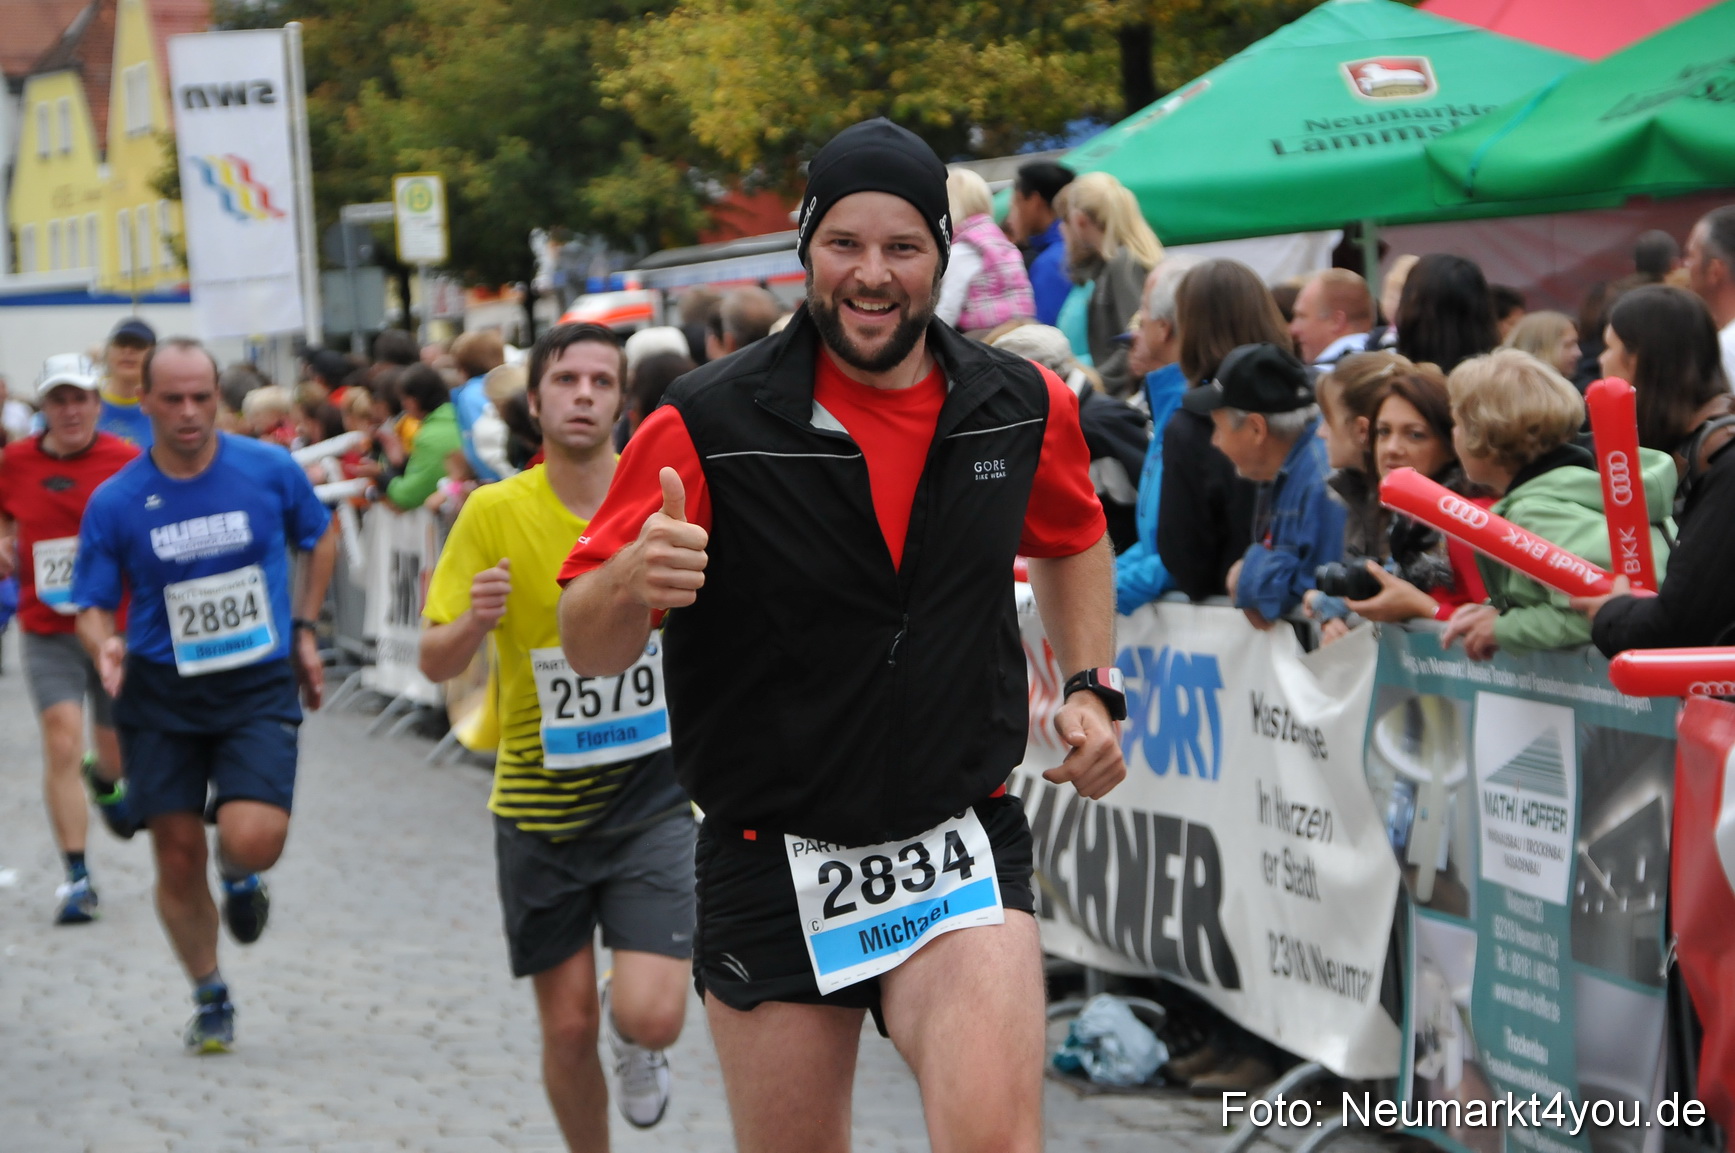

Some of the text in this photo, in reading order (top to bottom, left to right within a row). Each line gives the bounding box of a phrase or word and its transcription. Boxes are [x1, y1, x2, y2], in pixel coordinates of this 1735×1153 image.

[974, 459, 1006, 473] GORE
[975, 471, 1007, 481] BIKE WEAR
[150, 510, 250, 549] HUBER
[1501, 527, 1604, 585] Audi BKK
[1619, 526, 1641, 573] BKK
[43, 557, 74, 586] 22
[178, 591, 259, 637] 2884
[534, 658, 570, 672] PART
[549, 664, 655, 720] 2579
[576, 725, 638, 749] Florian
[1521, 799, 1568, 835] HOFFER
[792, 839, 847, 858] PART
[817, 829, 976, 920] 2834
[858, 899, 950, 955] Michael
